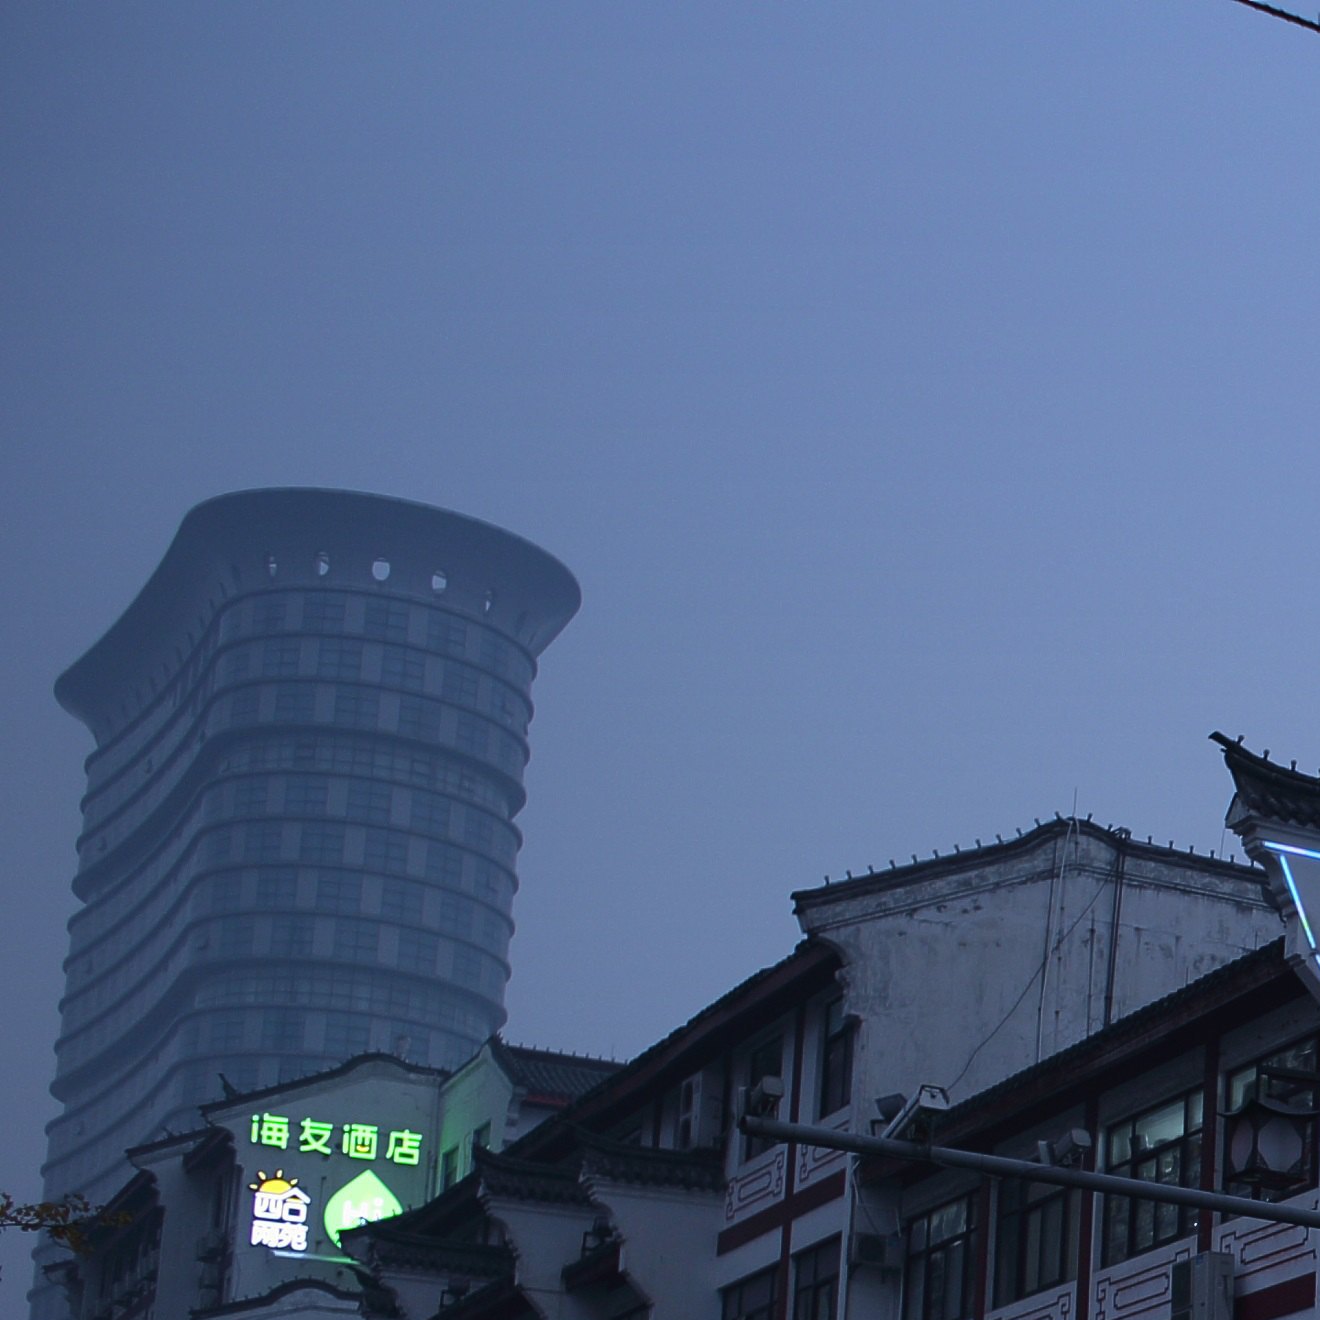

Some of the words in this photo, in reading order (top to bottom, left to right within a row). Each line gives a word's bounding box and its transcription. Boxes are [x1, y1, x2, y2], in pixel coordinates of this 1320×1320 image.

[251, 1113, 422, 1165] 海友酒店
[254, 1187, 311, 1223] 四合
